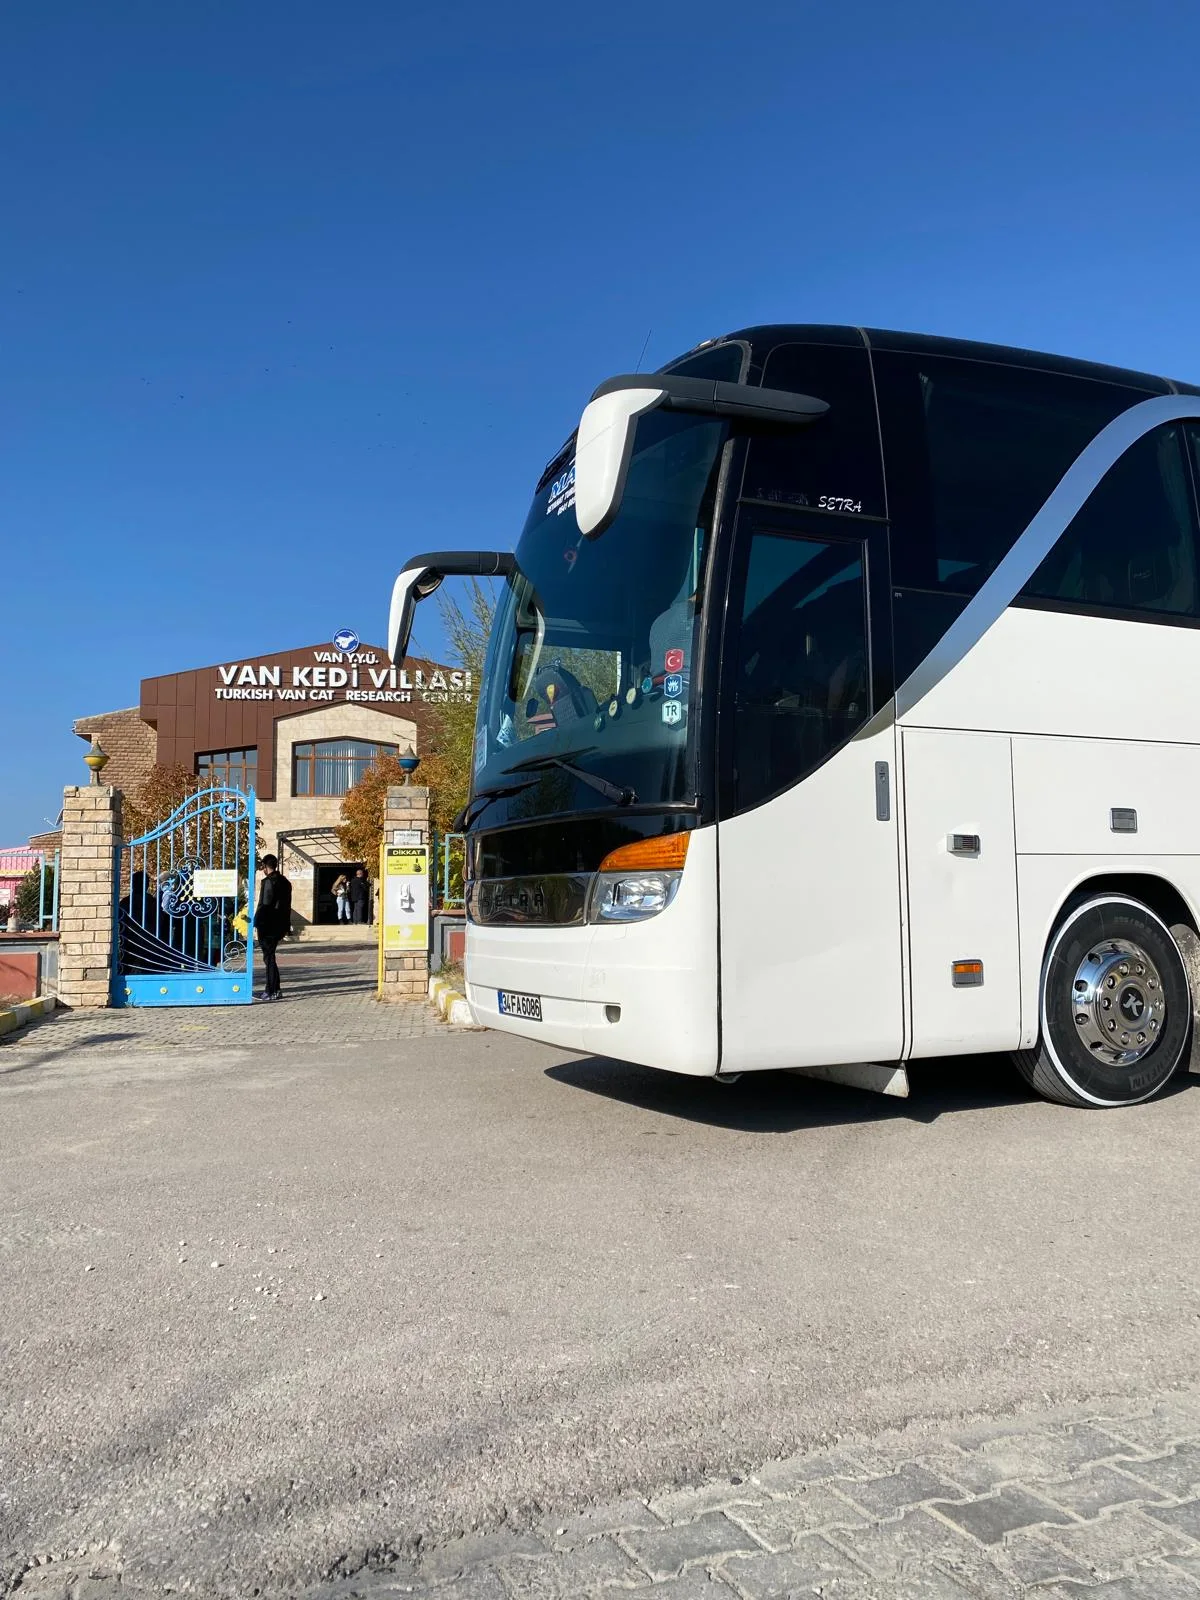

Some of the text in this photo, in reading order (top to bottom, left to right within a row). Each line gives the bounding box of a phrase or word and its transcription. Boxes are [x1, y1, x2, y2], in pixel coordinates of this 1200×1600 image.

[818, 496, 861, 512] SETRA
[314, 652, 343, 663] VAN
[218, 663, 472, 691] VAN KEDİ VİLLASI
[215, 688, 472, 704] TURKISH VAN CAT RESEARCH CENTER
[665, 705, 677, 716] TR
[483, 894, 544, 906] SETRA
